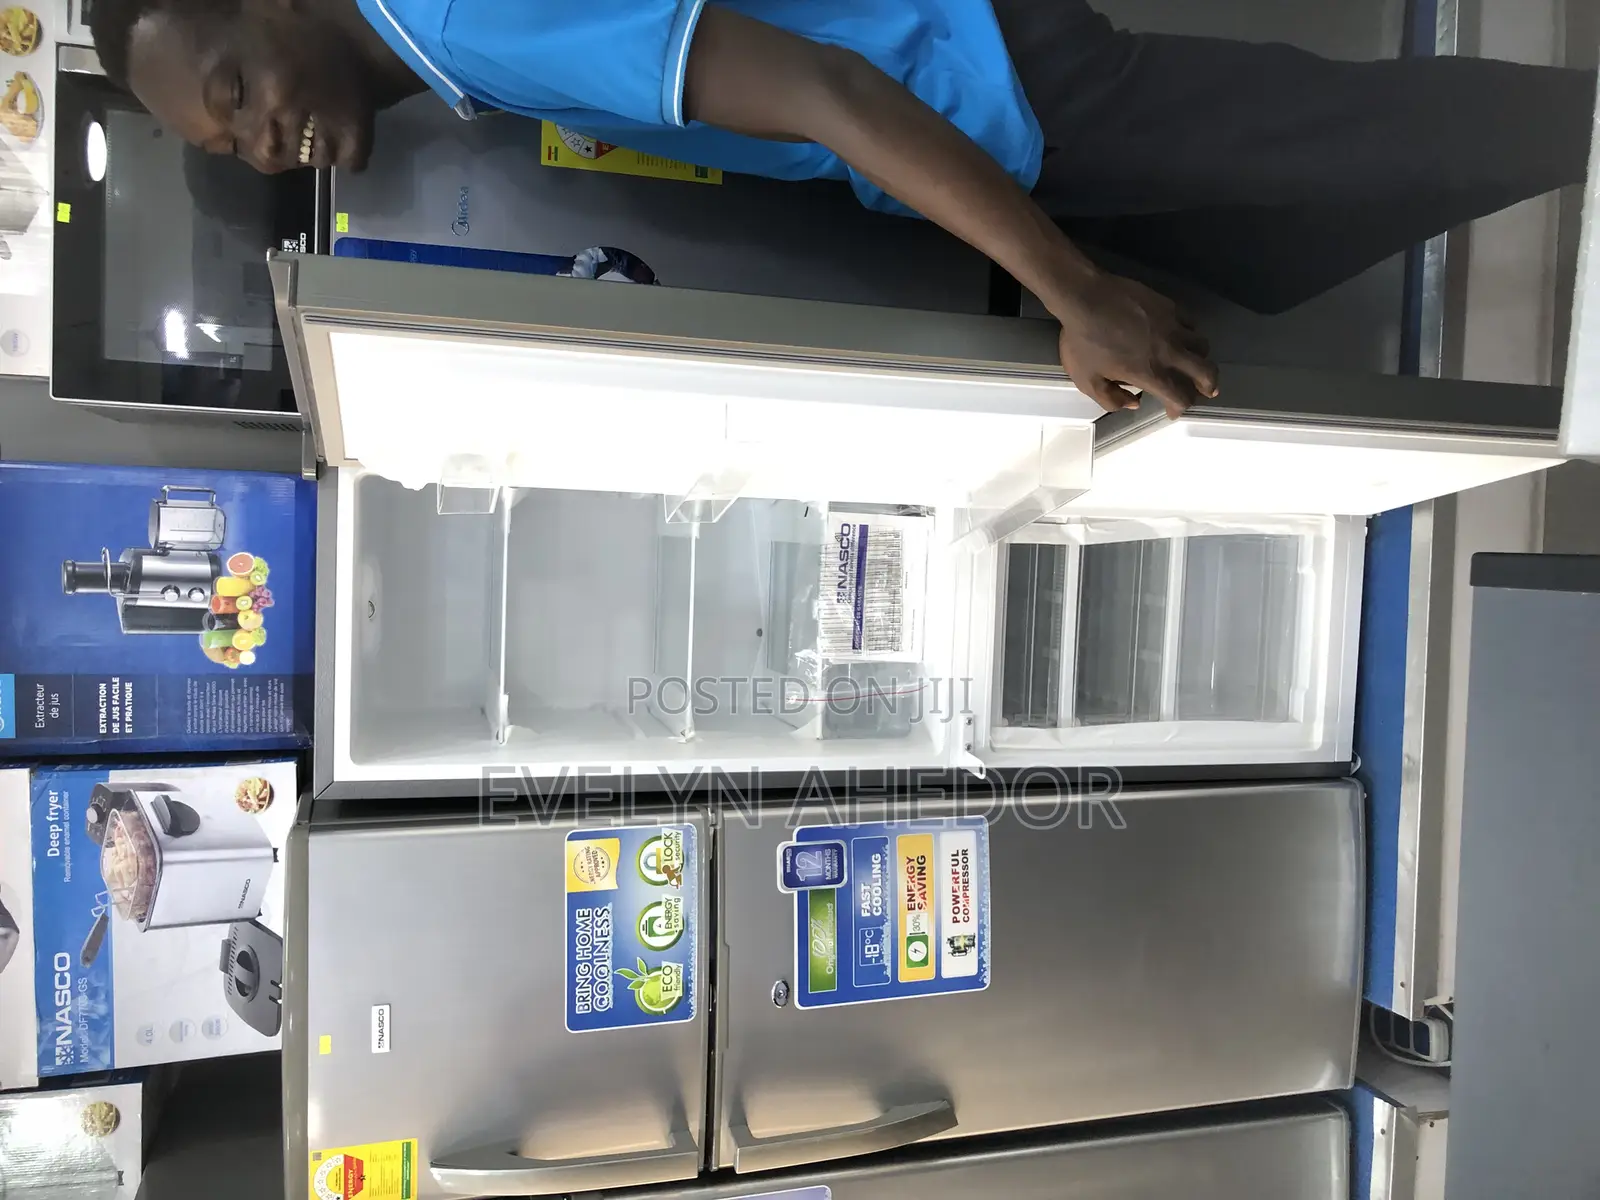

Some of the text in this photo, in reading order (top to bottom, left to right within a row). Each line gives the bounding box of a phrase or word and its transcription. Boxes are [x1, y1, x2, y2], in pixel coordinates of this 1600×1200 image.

[836, 523, 851, 589] NASCO
[34, 683, 44, 728] Extracteur
[48, 693, 60, 718] de jus
[112, 677, 120, 733] DE JUS FACILE
[125, 723, 132, 733] ET
[46, 790, 63, 857] Deep fryer
[664, 832, 673, 862] LOCK
[795, 850, 822, 882] 12
[872, 853, 882, 916] COOLING
[906, 856, 921, 932] 30% ENERGY
[917, 855, 927, 911] SAVING
[951, 849, 960, 923] POWERFUL
[962, 848, 970, 923] COMPRESSOR
[664, 898, 672, 930] ENERGY
[861, 883, 871, 917] FAST
[576, 908, 592, 1014] BRING HOME
[593, 905, 612, 1011] COOLNESS
[662, 965, 673, 992] ECO
[54, 952, 72, 1045] NASCO
